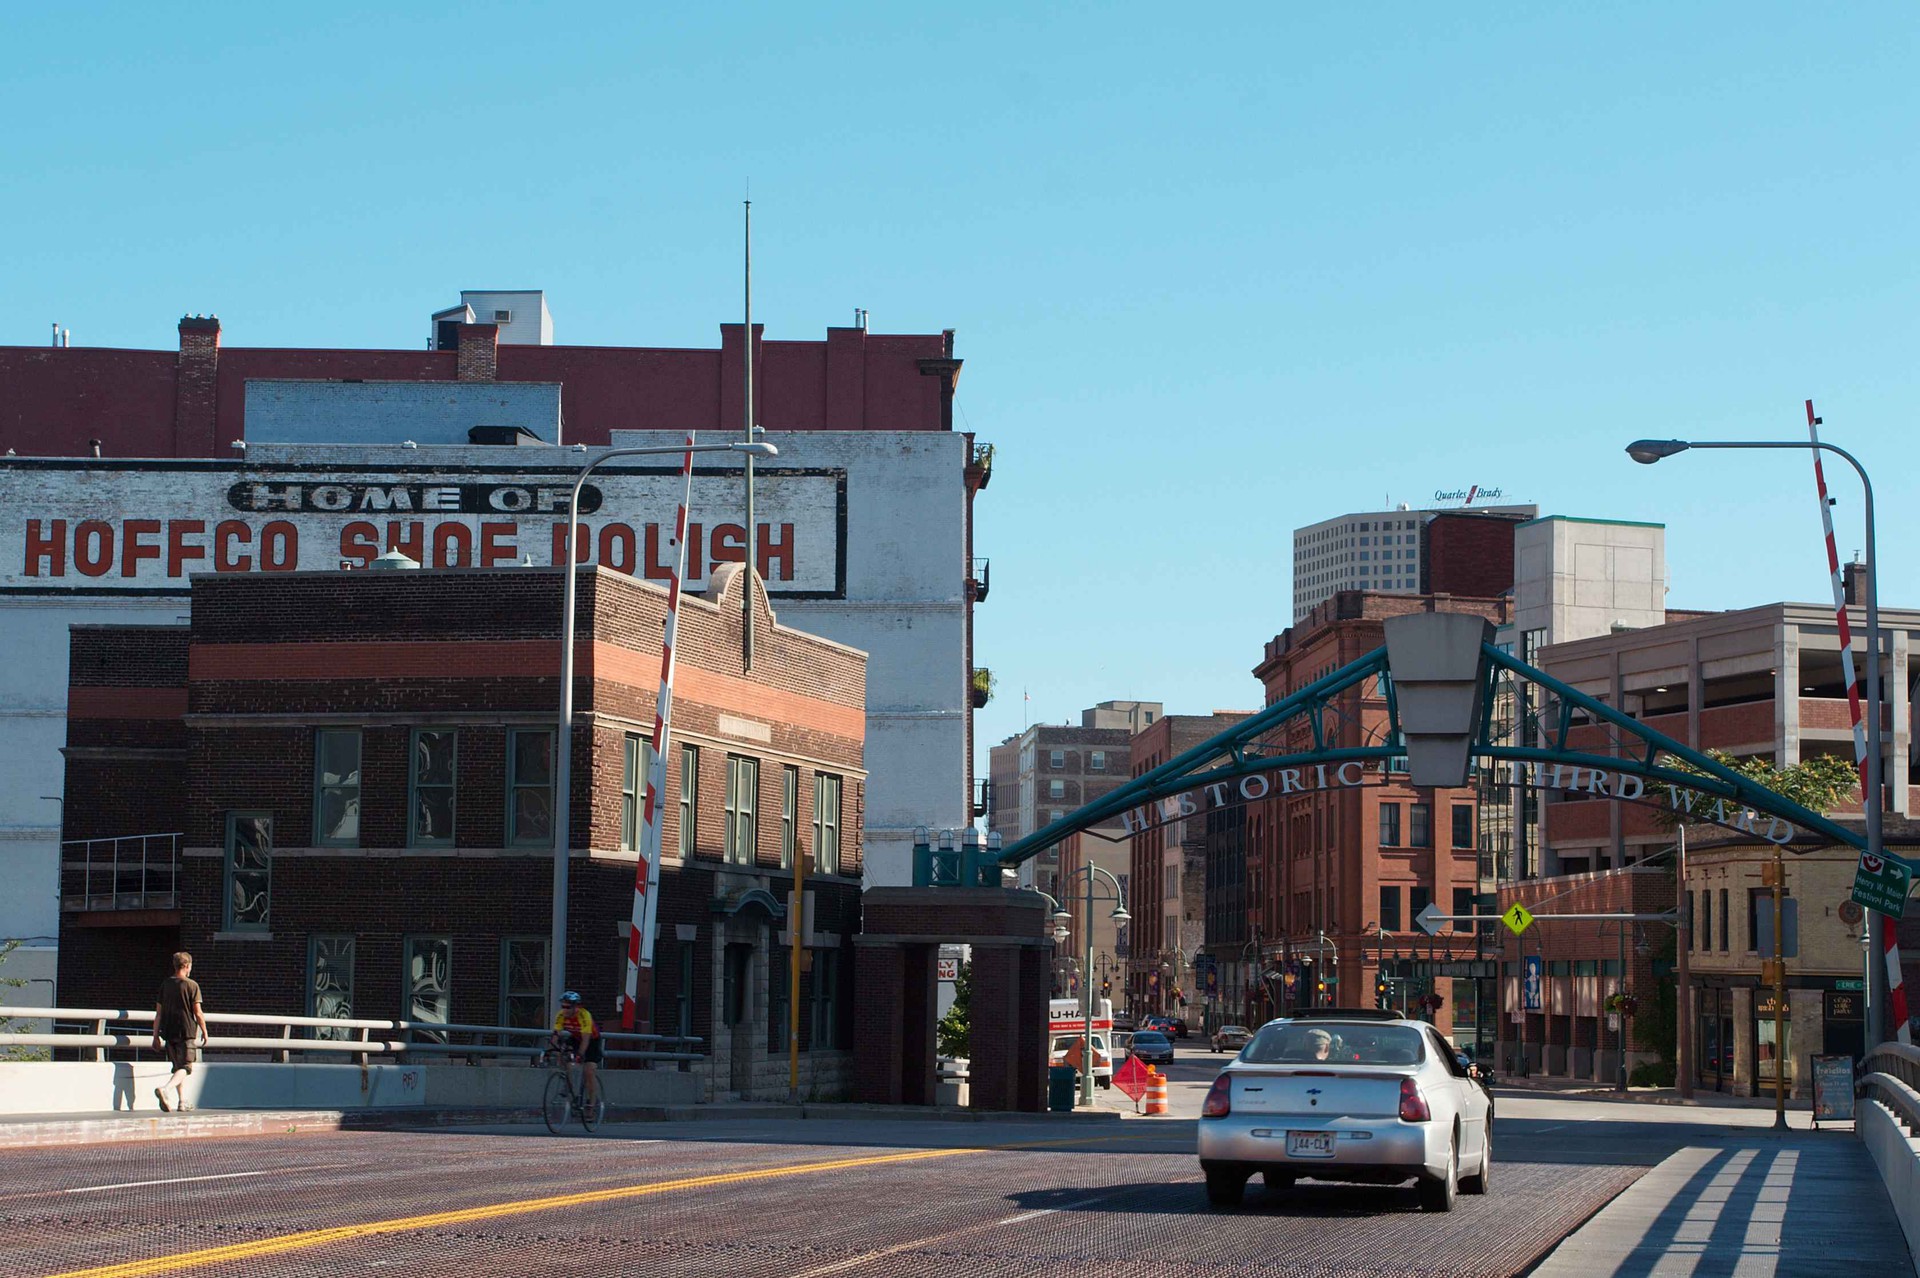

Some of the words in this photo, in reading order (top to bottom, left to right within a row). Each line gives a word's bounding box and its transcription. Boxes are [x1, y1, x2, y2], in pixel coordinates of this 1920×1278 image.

[249, 486, 461, 511] HOME
[488, 487, 578, 511] OF
[1434, 489, 1467, 501] Quarles
[1476, 487, 1502, 499] Brady
[24, 518, 299, 578] HOFFCO
[339, 521, 518, 570] SHOE
[551, 522, 795, 582] POLISH
[1120, 761, 1365, 837] HISTORIC
[1511, 761, 1644, 801] THIRD
[1669, 784, 1795, 846] WARD
[1856, 874, 1874, 889] Henry
[1853, 887, 1882, 904] Festival
[1884, 899, 1901, 912] Park
